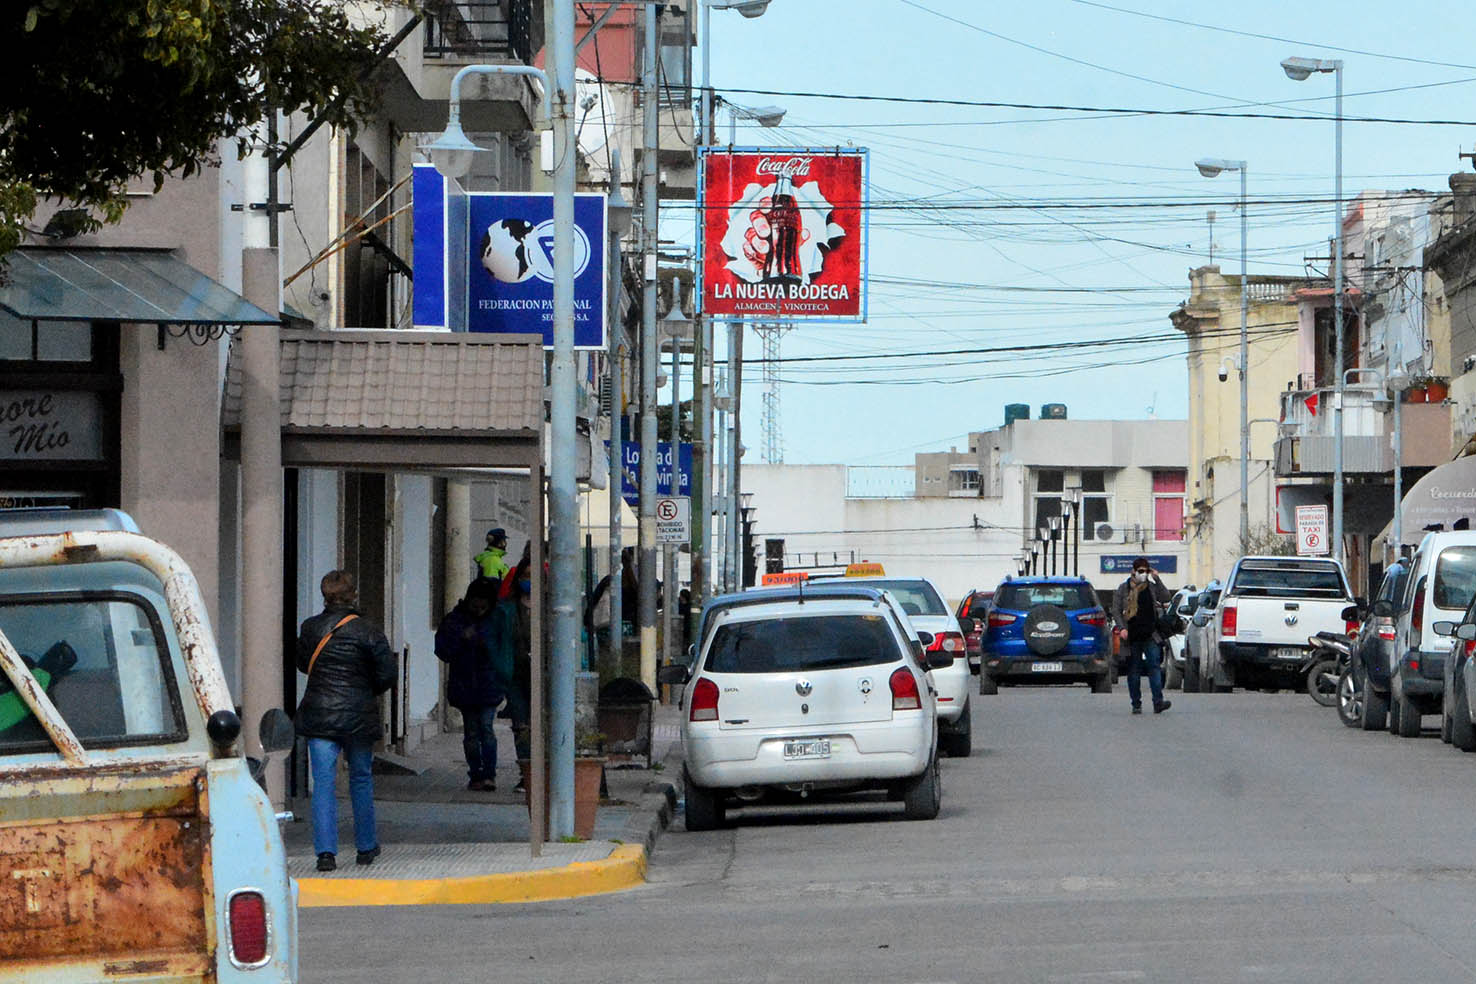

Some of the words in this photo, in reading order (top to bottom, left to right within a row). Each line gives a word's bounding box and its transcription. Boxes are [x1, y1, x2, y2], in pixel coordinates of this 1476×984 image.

[756, 157, 814, 176] Coca-Cola
[714, 283, 733, 299] LA
[736, 284, 786, 299] NUEVA
[789, 284, 849, 300] BODEGA
[479, 300, 541, 310] FEDERACION
[542, 299, 592, 310] PANAL
[785, 303, 830, 311] VINOTECA
[0, 394, 53, 424] ore
